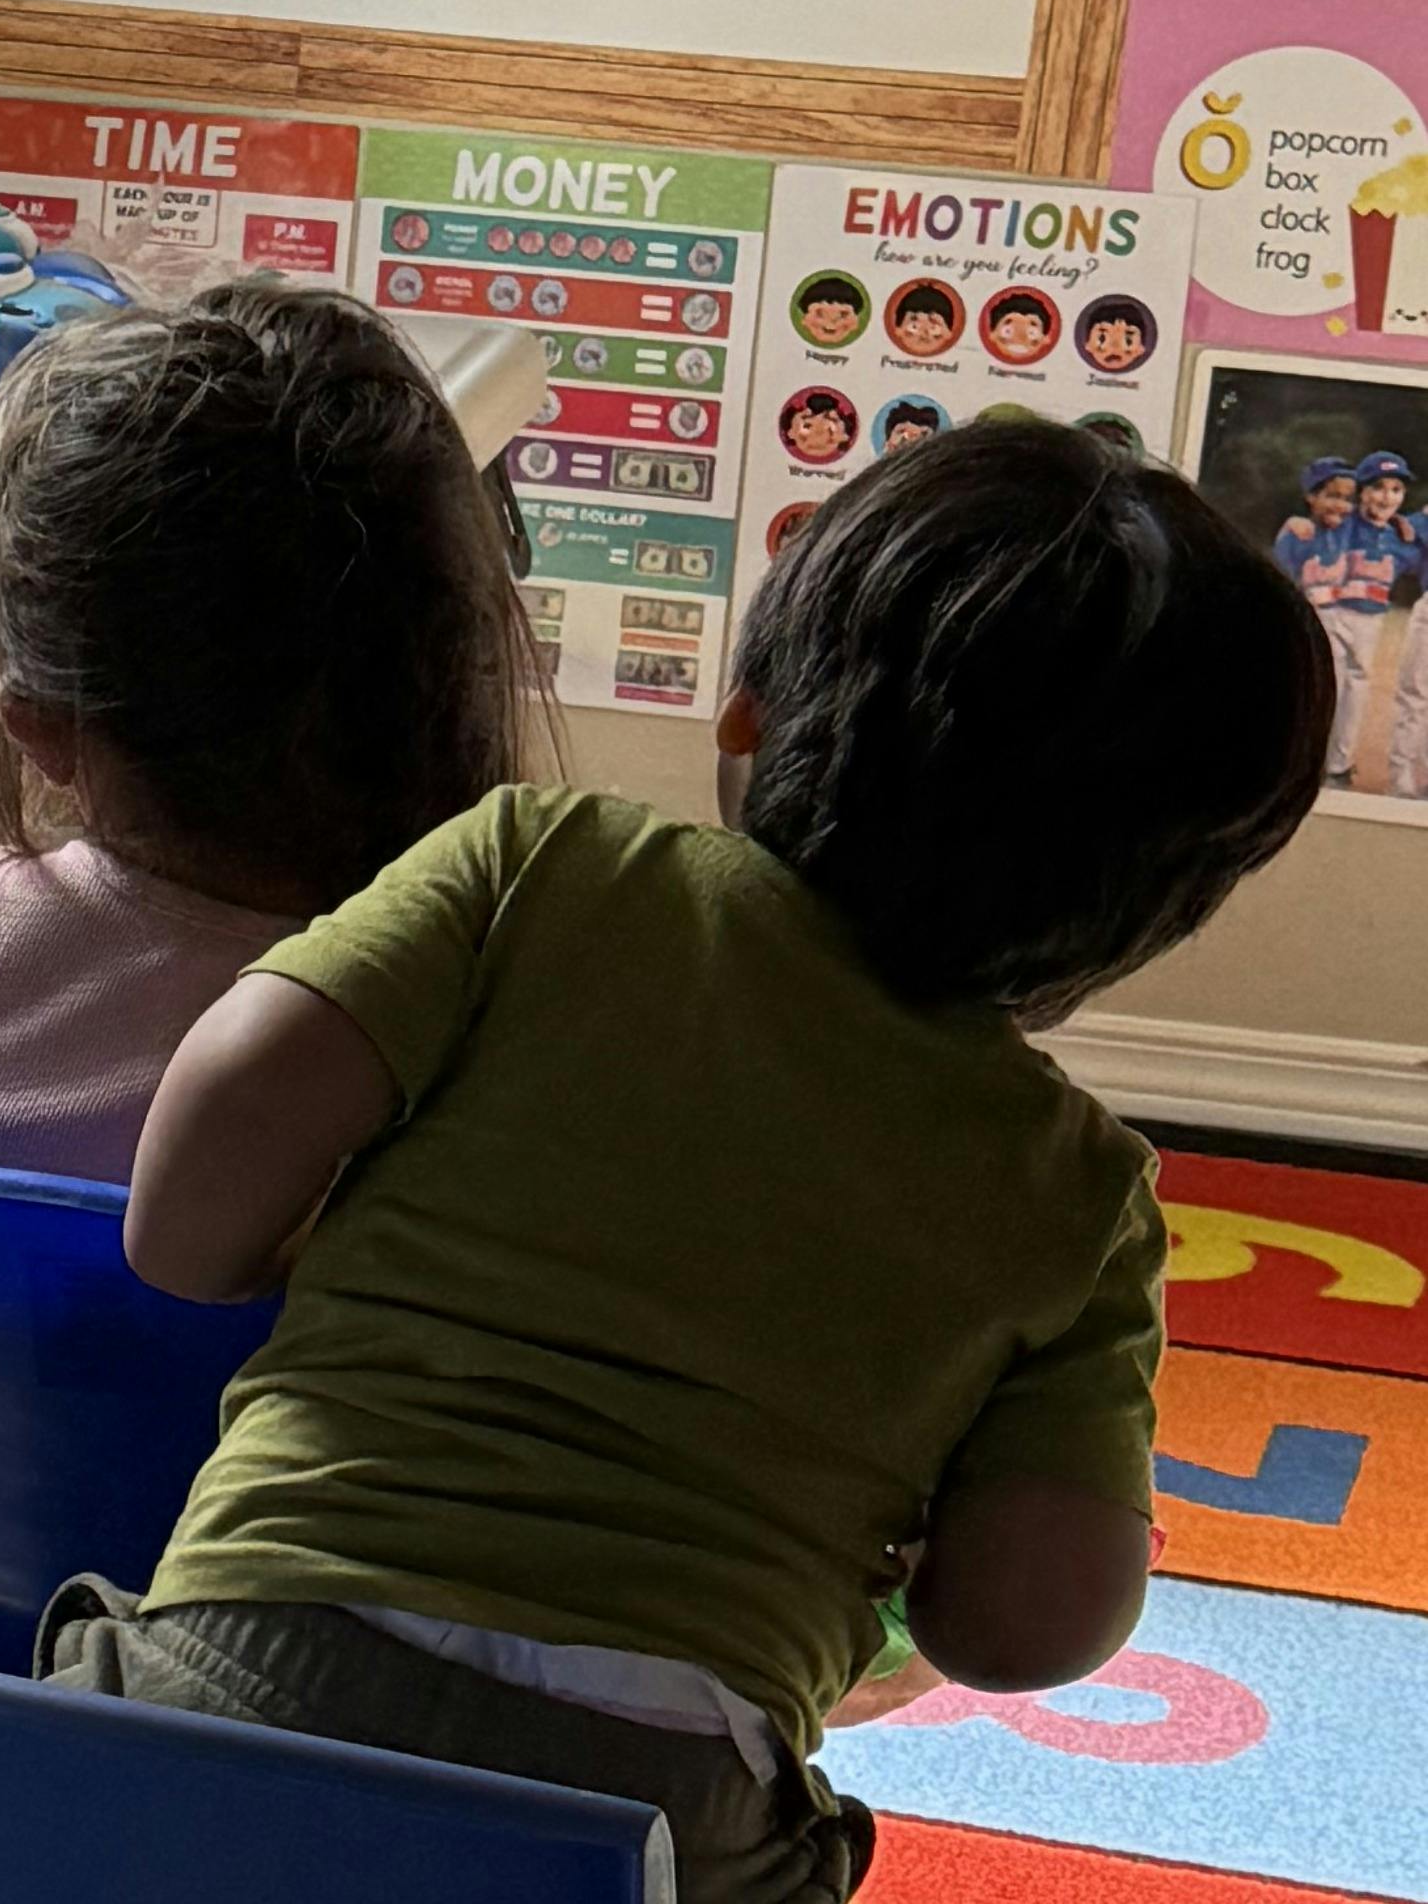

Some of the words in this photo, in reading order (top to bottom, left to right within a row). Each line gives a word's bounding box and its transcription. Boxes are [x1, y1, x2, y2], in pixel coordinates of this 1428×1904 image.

[85, 116, 242, 178] TIME
[1269, 129, 1389, 159] popcorn
[451, 148, 677, 218] MONEY
[1265, 162, 1320, 194] box
[843, 187, 1141, 256] EMOTIONS
[1259, 203, 1332, 236] clock
[873, 241, 913, 264] how
[922, 252, 959, 270] are
[962, 257, 1005, 281] you
[1006, 255, 1100, 291] feeling?
[1256, 241, 1311, 279] frog
